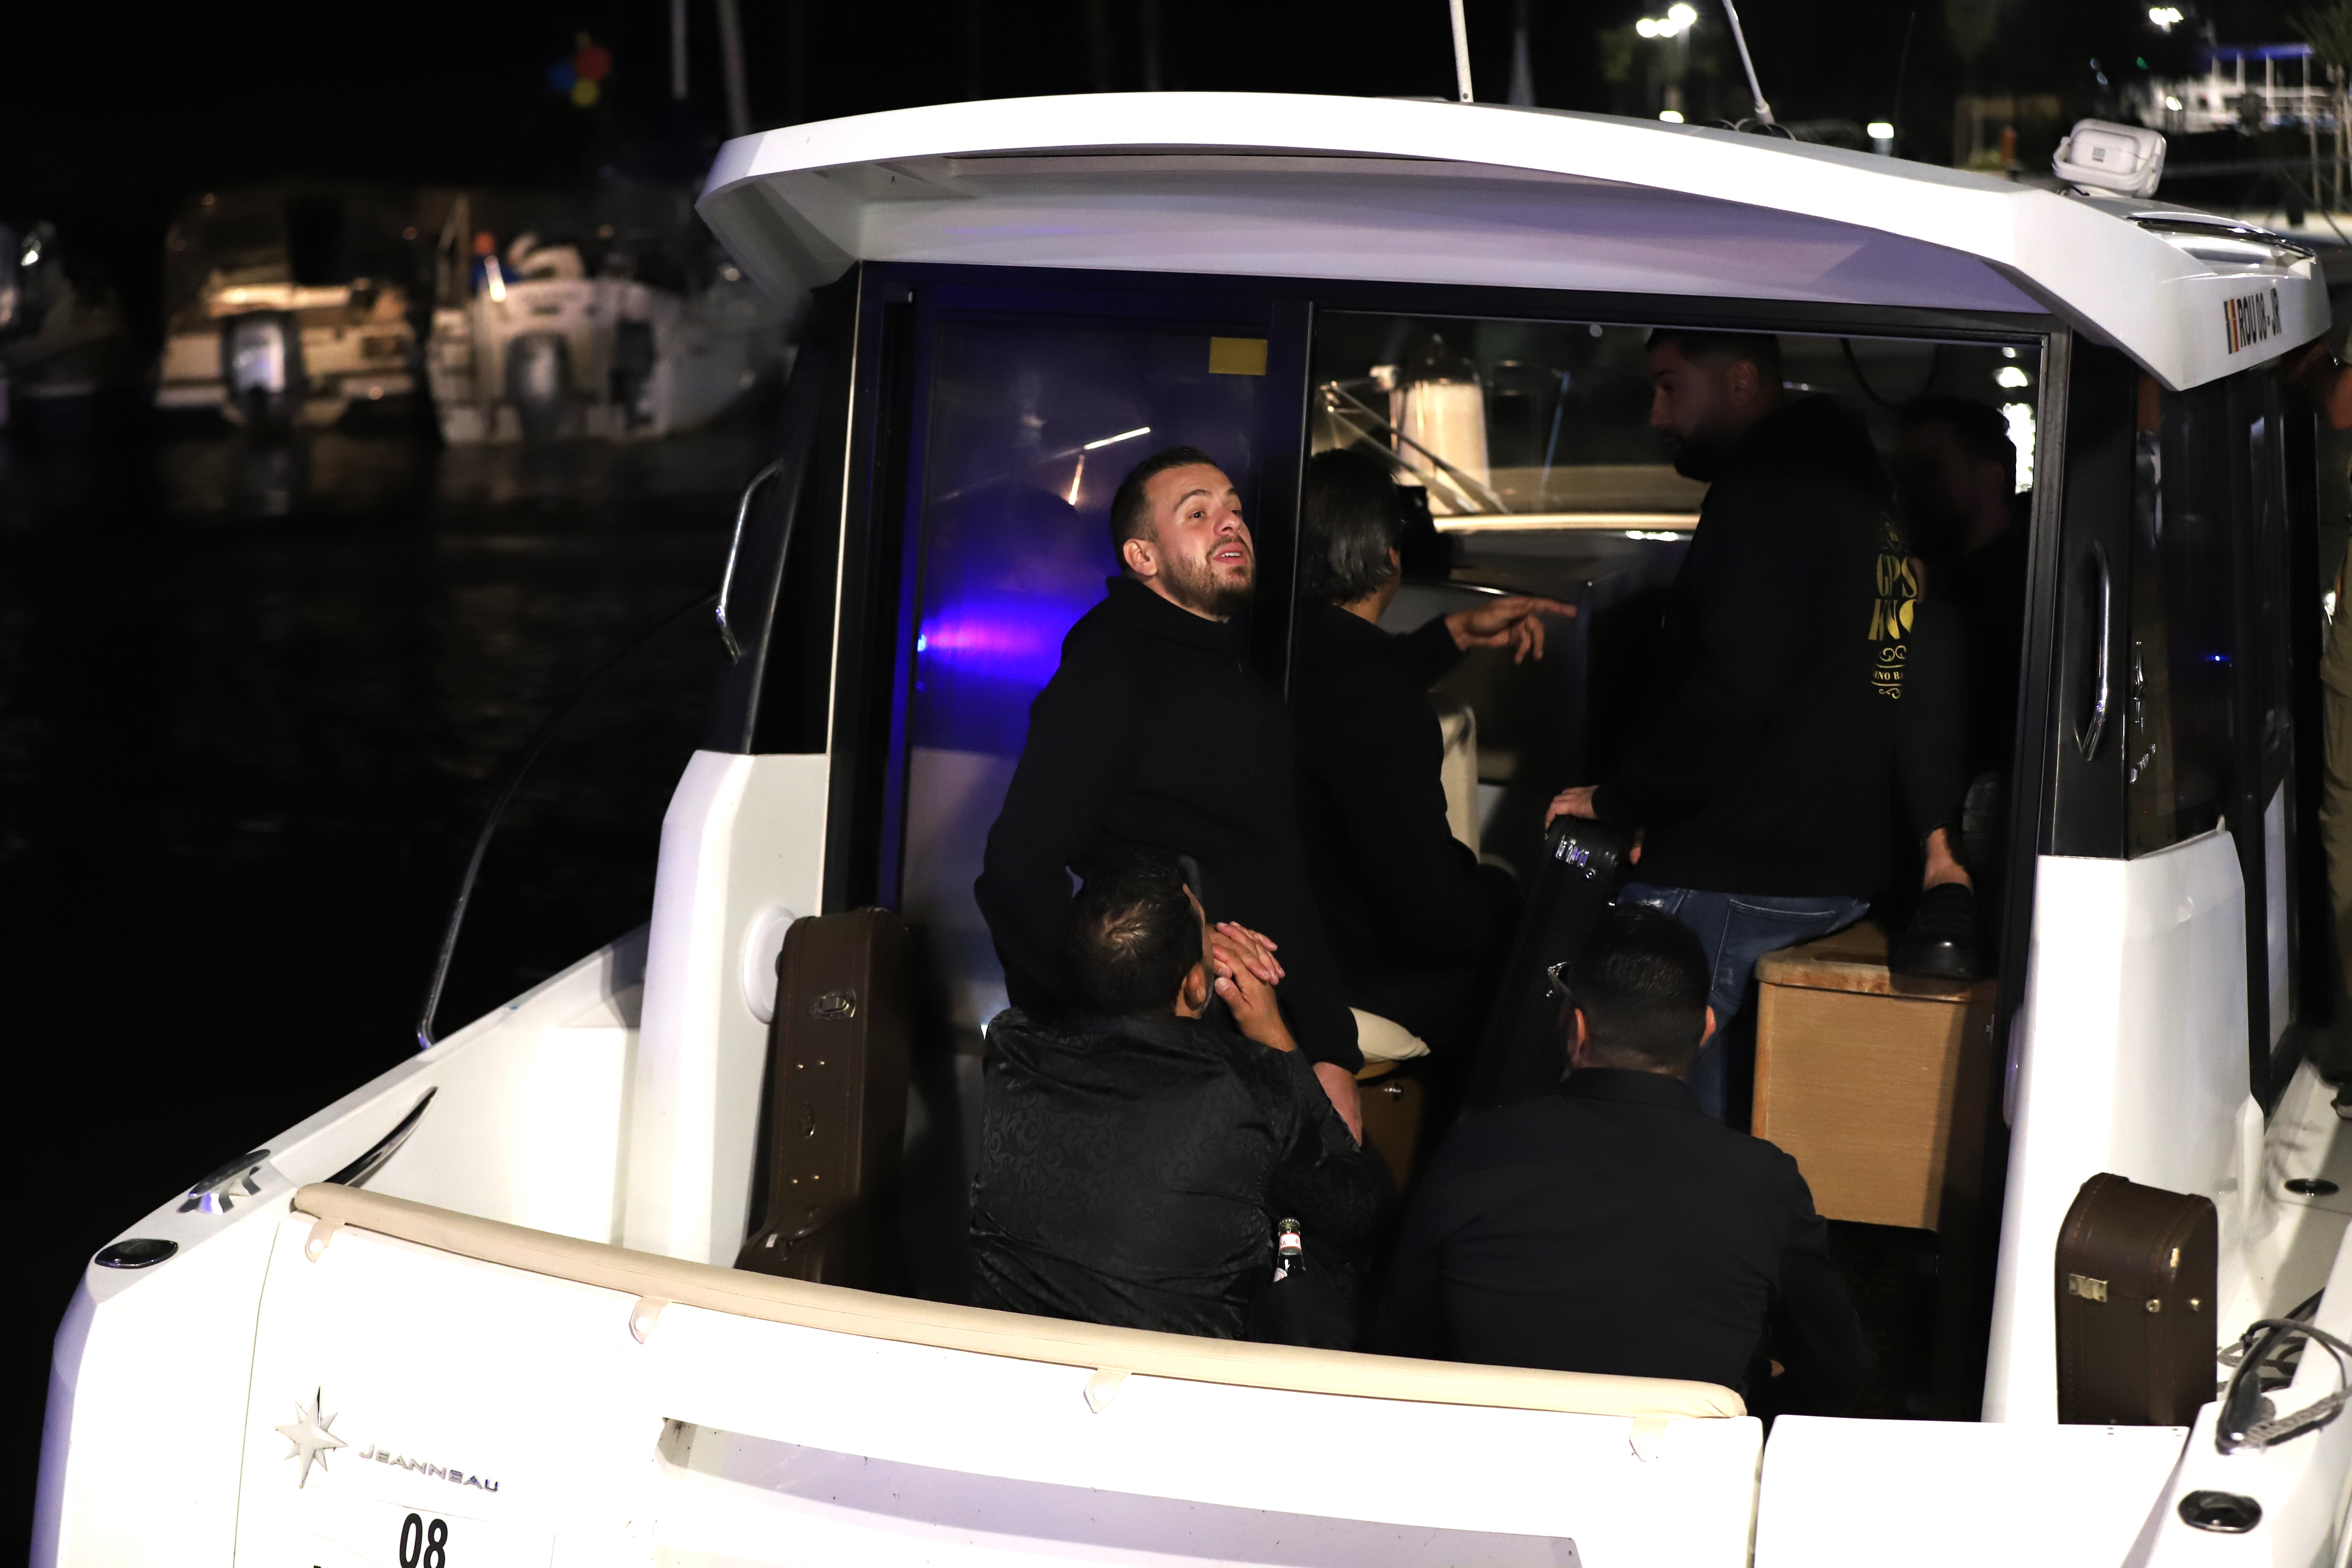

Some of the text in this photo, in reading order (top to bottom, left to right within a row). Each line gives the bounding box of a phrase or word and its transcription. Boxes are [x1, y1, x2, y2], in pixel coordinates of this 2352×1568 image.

[2237, 295, 2256, 348] ROU
[358, 1443, 500, 1493] JEANNEAU
[400, 1513, 448, 1568] 08
